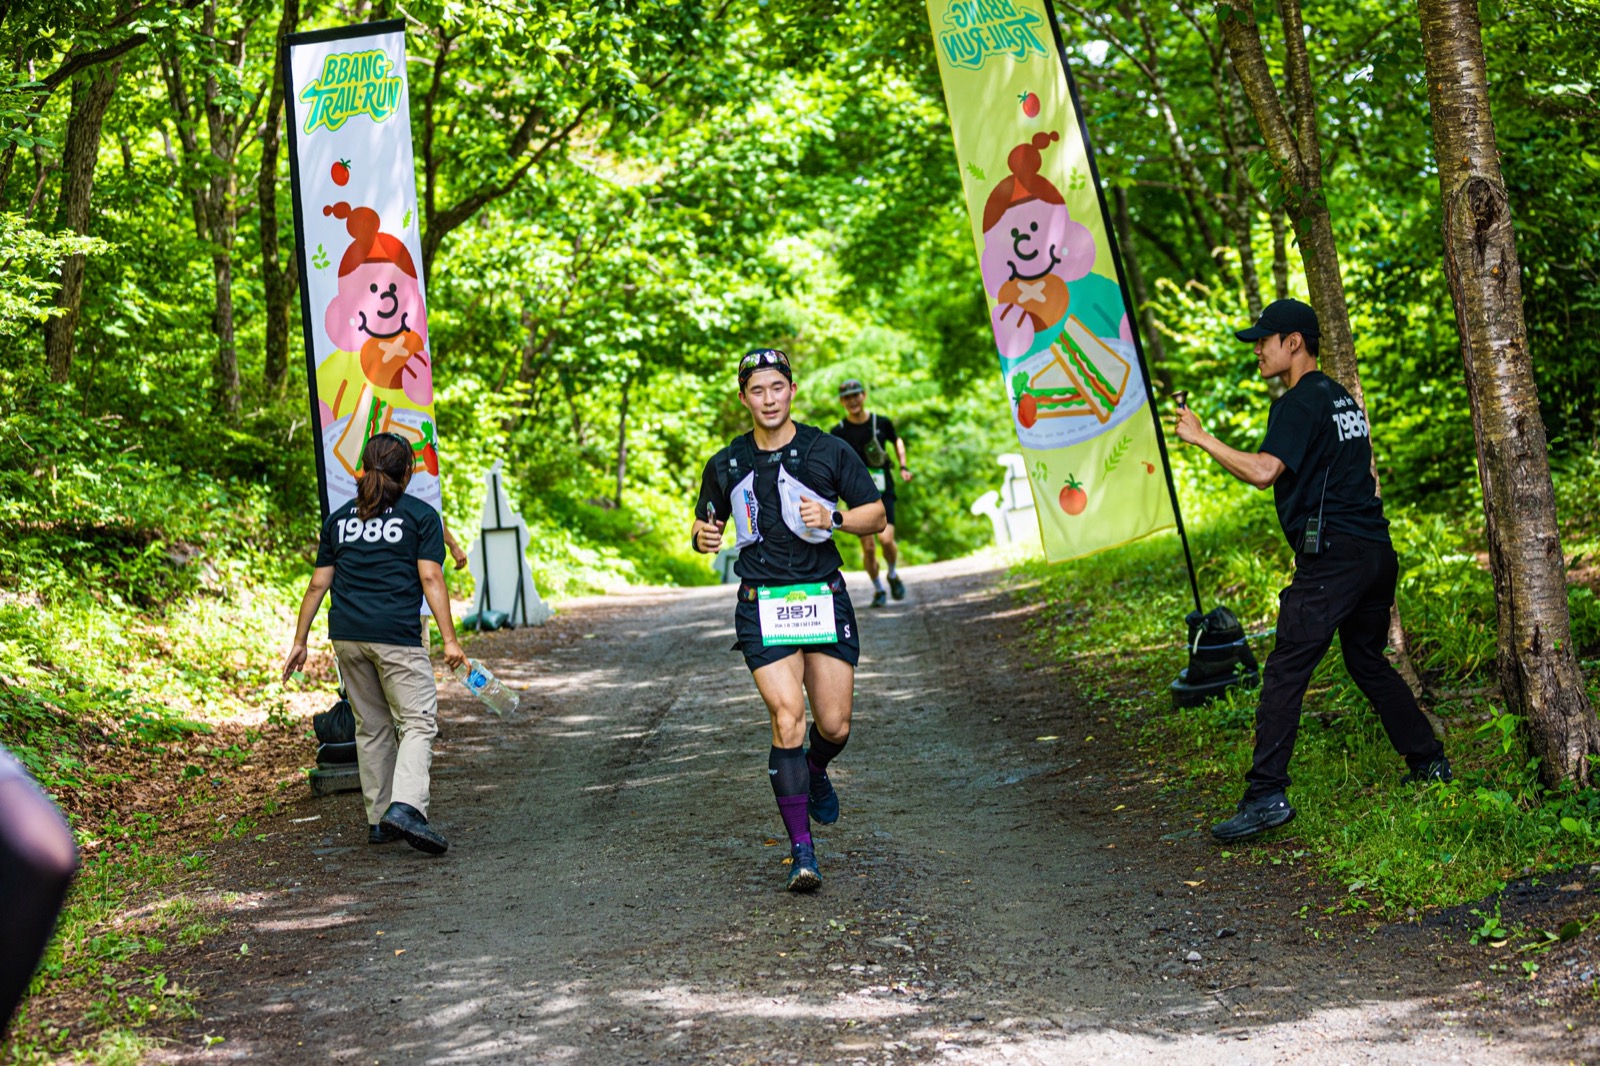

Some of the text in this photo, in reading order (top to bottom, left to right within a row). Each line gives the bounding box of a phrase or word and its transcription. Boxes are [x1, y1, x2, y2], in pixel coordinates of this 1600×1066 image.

[323, 53, 385, 87] BBANG
[1332, 410, 1368, 442] 1986
[337, 518, 404, 544] 1986
[776, 604, 817, 621] 김웅기
